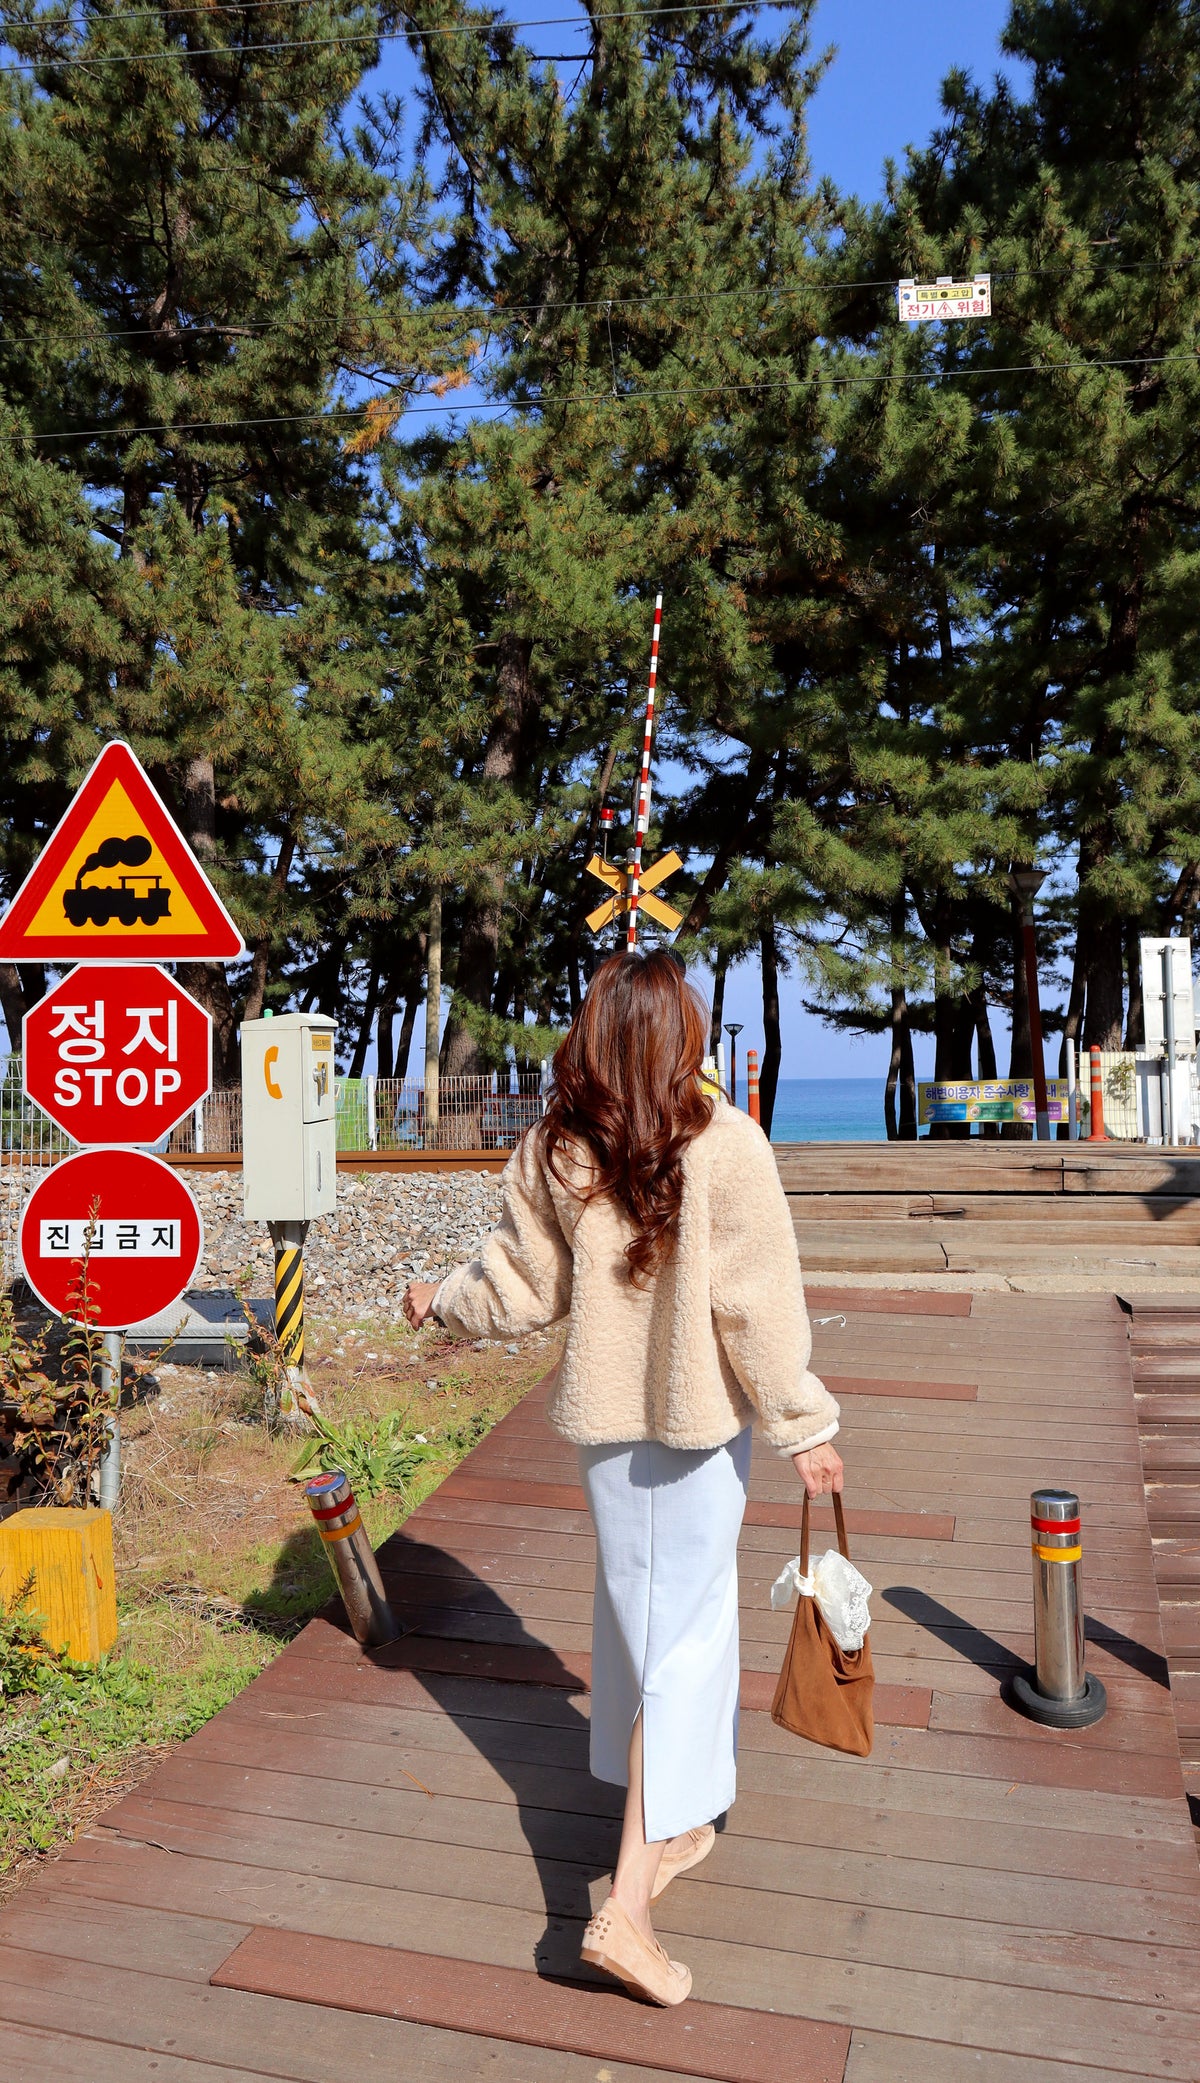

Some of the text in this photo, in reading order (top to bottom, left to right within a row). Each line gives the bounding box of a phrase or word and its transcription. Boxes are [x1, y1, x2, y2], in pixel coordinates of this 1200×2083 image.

[951, 289, 969, 298] 고압
[907, 300, 984, 317] 전기 위험
[48, 1000, 179, 1063] 정지
[53, 1068, 182, 1107] STOP
[925, 1086, 981, 1100] 해변이용자
[984, 1084, 1030, 1098] 준수사항
[46, 1224, 175, 1250] 진입금지
